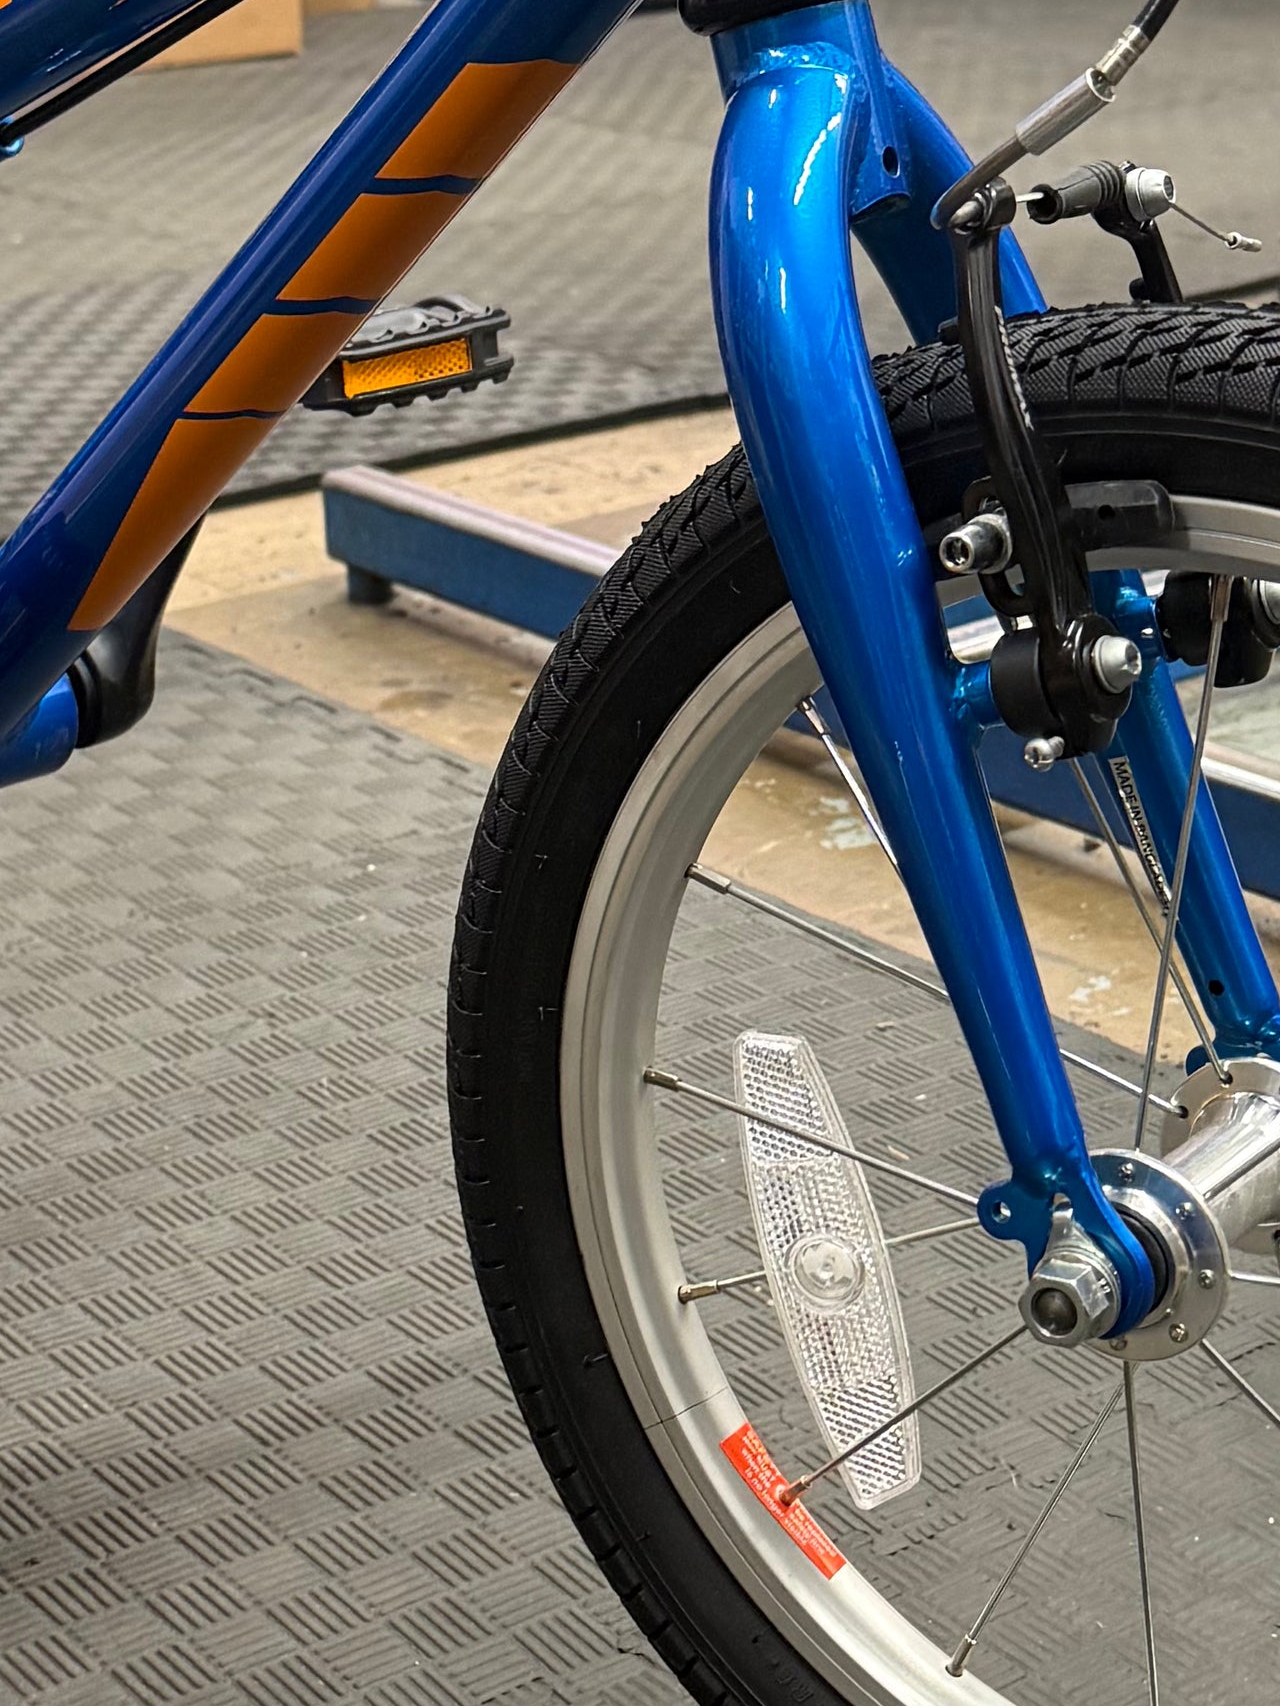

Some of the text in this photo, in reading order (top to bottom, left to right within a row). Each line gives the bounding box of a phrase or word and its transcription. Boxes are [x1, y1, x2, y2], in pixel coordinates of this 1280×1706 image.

[1113, 761, 1137, 804] MADE
[1131, 803, 1144, 821] IN
[741, 1448, 760, 1477] when
